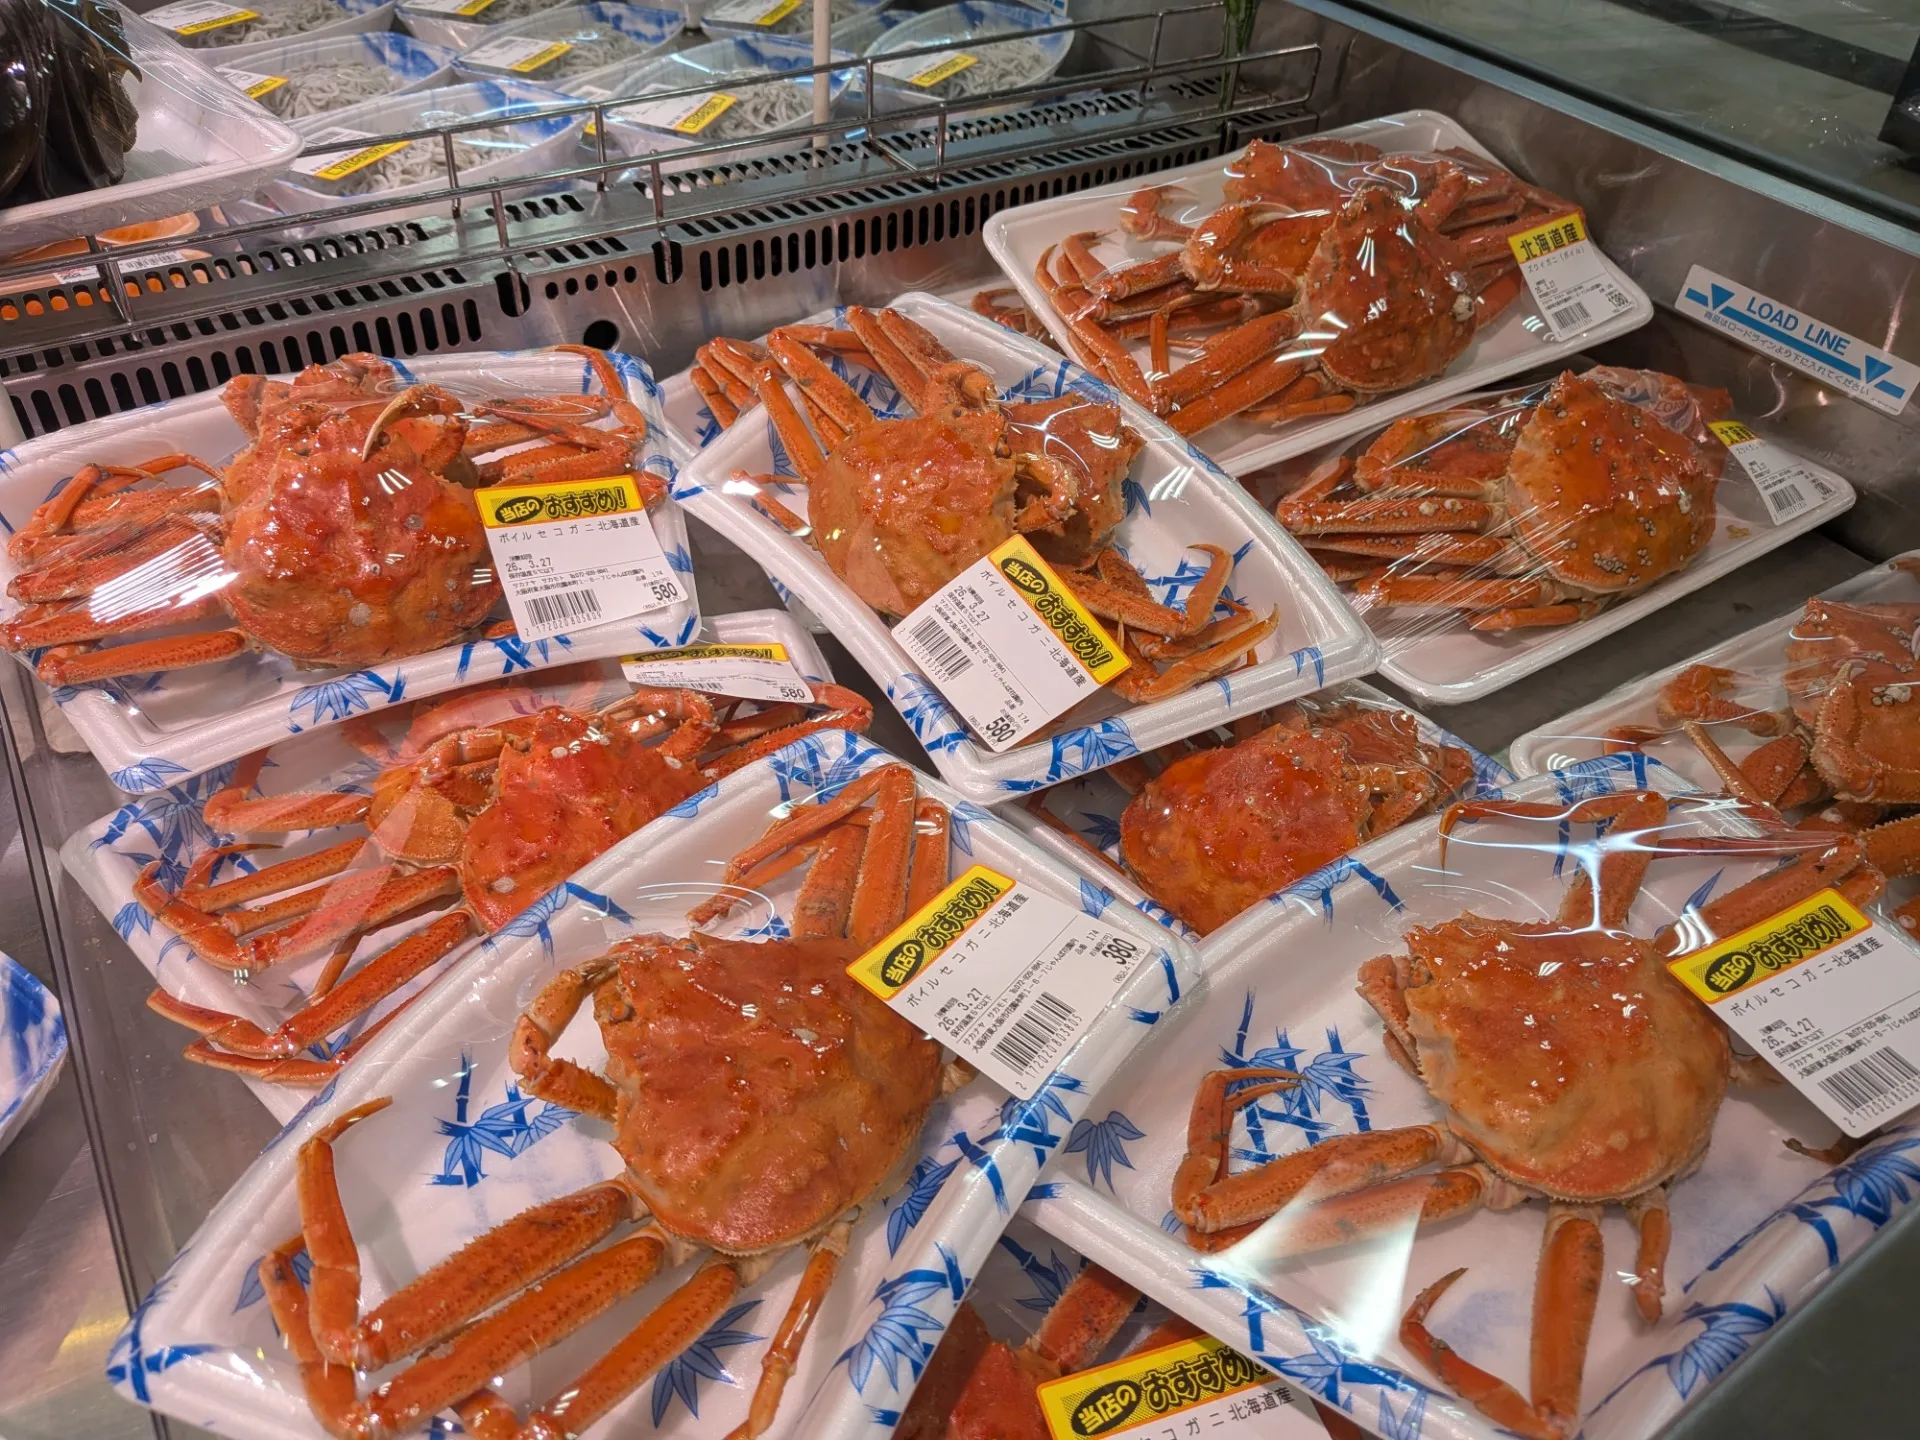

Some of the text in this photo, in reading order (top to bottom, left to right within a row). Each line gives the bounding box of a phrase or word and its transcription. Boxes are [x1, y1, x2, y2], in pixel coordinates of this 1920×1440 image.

[1519, 223, 1579, 259] 北海道産
[1745, 296, 1851, 356] LOAD LINE
[1703, 310, 1870, 396] 商品はロードラインより下に入れてください
[651, 582, 678, 601] 580
[781, 688, 805, 698] 580
[984, 715, 1016, 744] 580
[1099, 936, 1139, 966] 380
